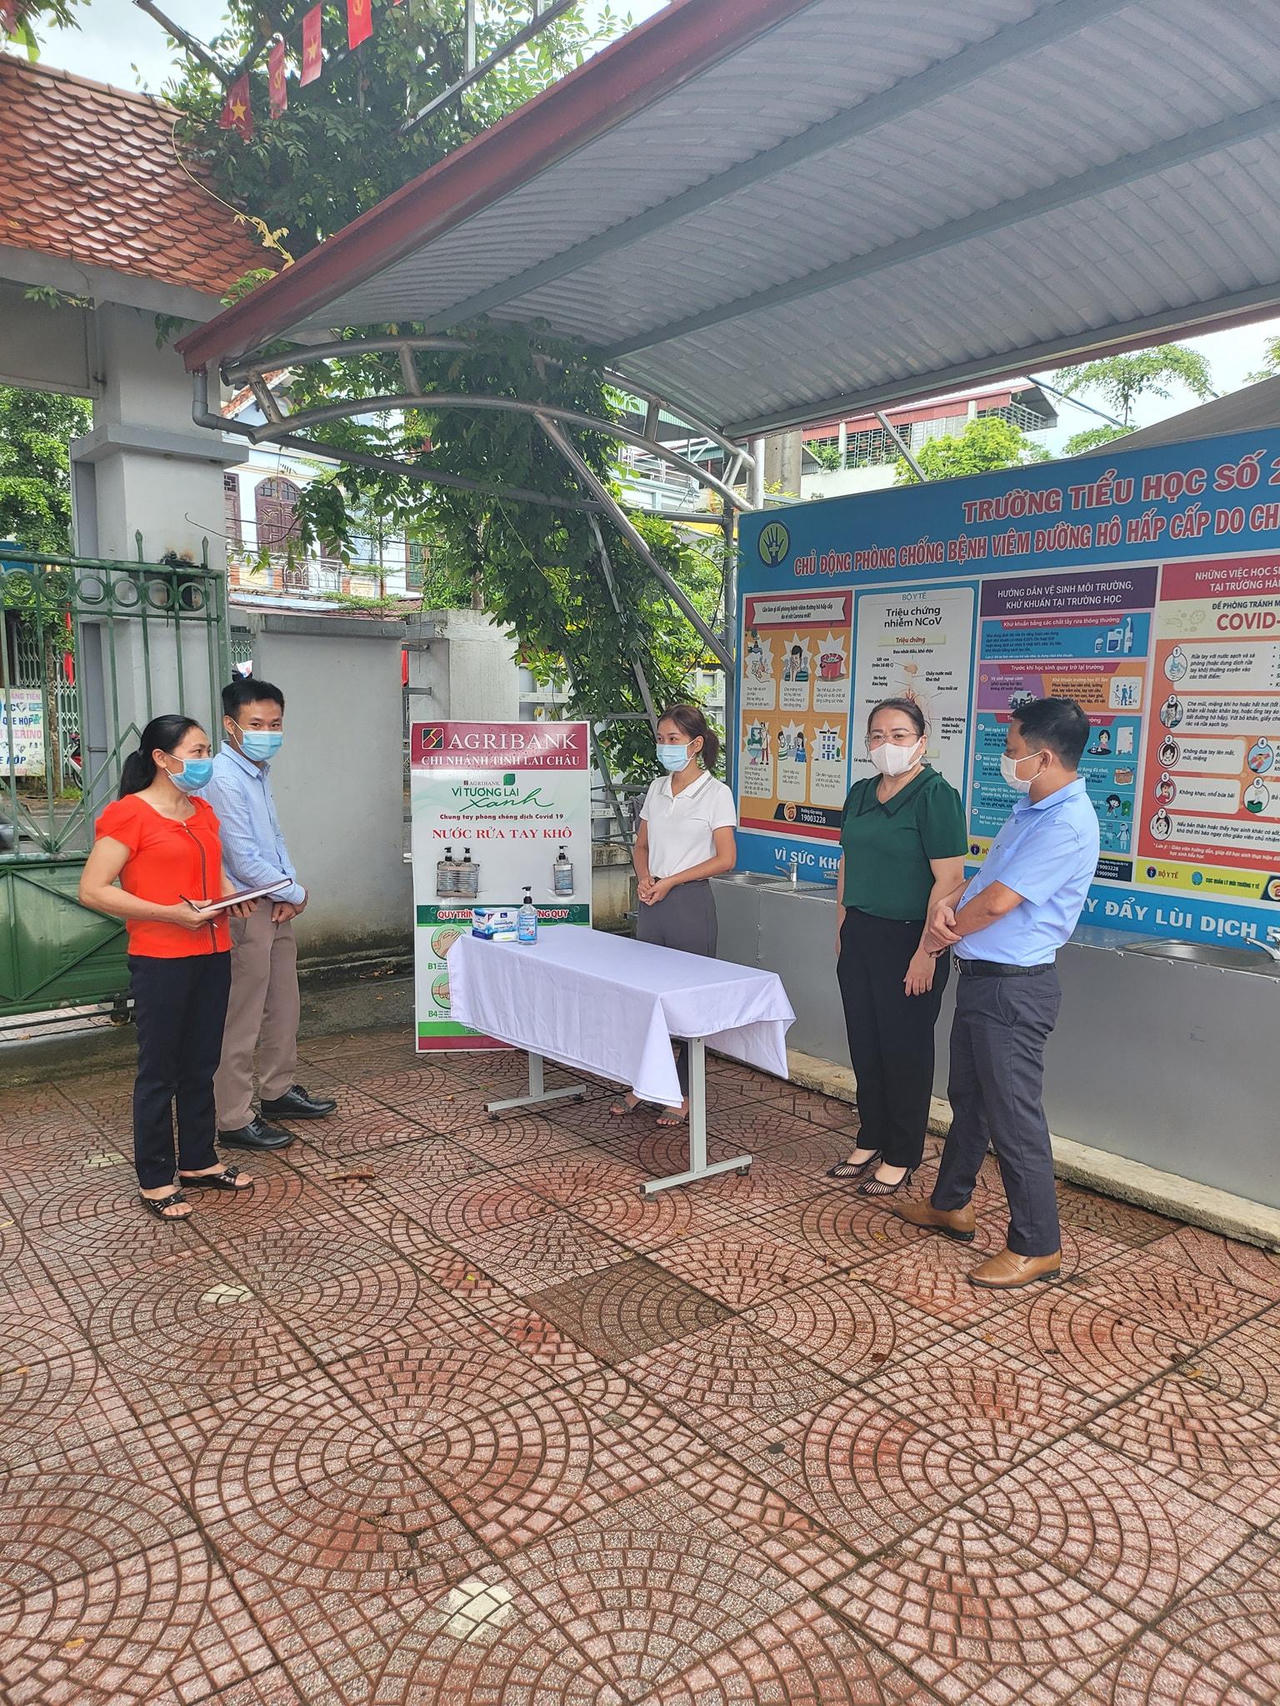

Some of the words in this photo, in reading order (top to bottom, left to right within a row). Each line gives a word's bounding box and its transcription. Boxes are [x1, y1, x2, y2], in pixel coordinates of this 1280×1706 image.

[963, 487, 1063, 524] TRƯỜNG
[1068, 468, 1134, 511] TIỂU
[1141, 467, 1206, 503] HỌC
[1213, 449, 1267, 491] SỐ
[794, 549, 817, 576] CHỦ
[819, 549, 851, 577] ĐỘNG
[853, 544, 896, 571] PHÒNG
[898, 536, 944, 567] CHỐNG
[947, 534, 988, 565] BỆNH
[992, 527, 1030, 555] VIÊM
[1034, 521, 1092, 553] ĐƯỜNG
[1095, 514, 1122, 546] HÔ
[1126, 507, 1167, 543] HẤP
[1169, 502, 1211, 540] CẤP
[1213, 506, 1246, 536] DO
[1195, 569, 1227, 581] NHỮNG
[1229, 567, 1249, 580] VIỆC
[1250, 566, 1271, 579] HỌC
[998, 588, 1025, 599] HƯỚNG
[1044, 584, 1054, 597] VỆ
[1056, 584, 1076, 594] SINH
[1077, 582, 1094, 593] MÔI
[1095, 579, 1134, 592] TRƯỜNG,
[1210, 582, 1224, 594] TẠI
[1225, 580, 1263, 591] TRƯỜNG
[1006, 599, 1024, 610] KHỬ
[1024, 597, 1051, 609] KHUẨN
[1053, 598, 1065, 608] TẠI
[1066, 595, 1101, 607] TRƯỜNG
[1103, 594, 1122, 606] HỌC
[1223, 599, 1248, 609] PHÒNG
[1249, 599, 1273, 608] TRÁNH
[886, 607, 909, 619] Triệu
[910, 606, 941, 617] chứng
[884, 617, 914, 628] nhiễm
[915, 616, 943, 627] NCoV
[448, 733, 579, 750] AGRIBANK
[421, 755, 445, 766] CHI
[447, 753, 489, 766] NHÁNH
[523, 755, 543, 766] LAI
[546, 752, 580, 766] CHÂU
[451, 786, 462, 797] VÌ
[463, 786, 501, 797] TƯƠNG
[504, 787, 519, 797] LAI
[475, 813, 497, 821] phòng
[498, 813, 519, 821] chống
[519, 813, 534, 821] dịch
[800, 814, 827, 824] 19003228
[432, 826, 473, 839] NƯỚC
[476, 826, 505, 839] RỬA
[509, 829, 538, 839] TAY
[543, 826, 573, 839] KHÔ
[774, 843, 787, 861] VÌ
[789, 847, 815, 867] SỨC
[1158, 870, 1166, 878] BỘ
[437, 910, 456, 920] QUY
[456, 908, 473, 919] TRÌN
[551, 909, 569, 919] QUY
[1105, 896, 1149, 921] ĐẨY
[1155, 907, 1193, 929] LÙI
[1200, 915, 1258, 941] DỊCH
[428, 1010, 438, 1018] B4
